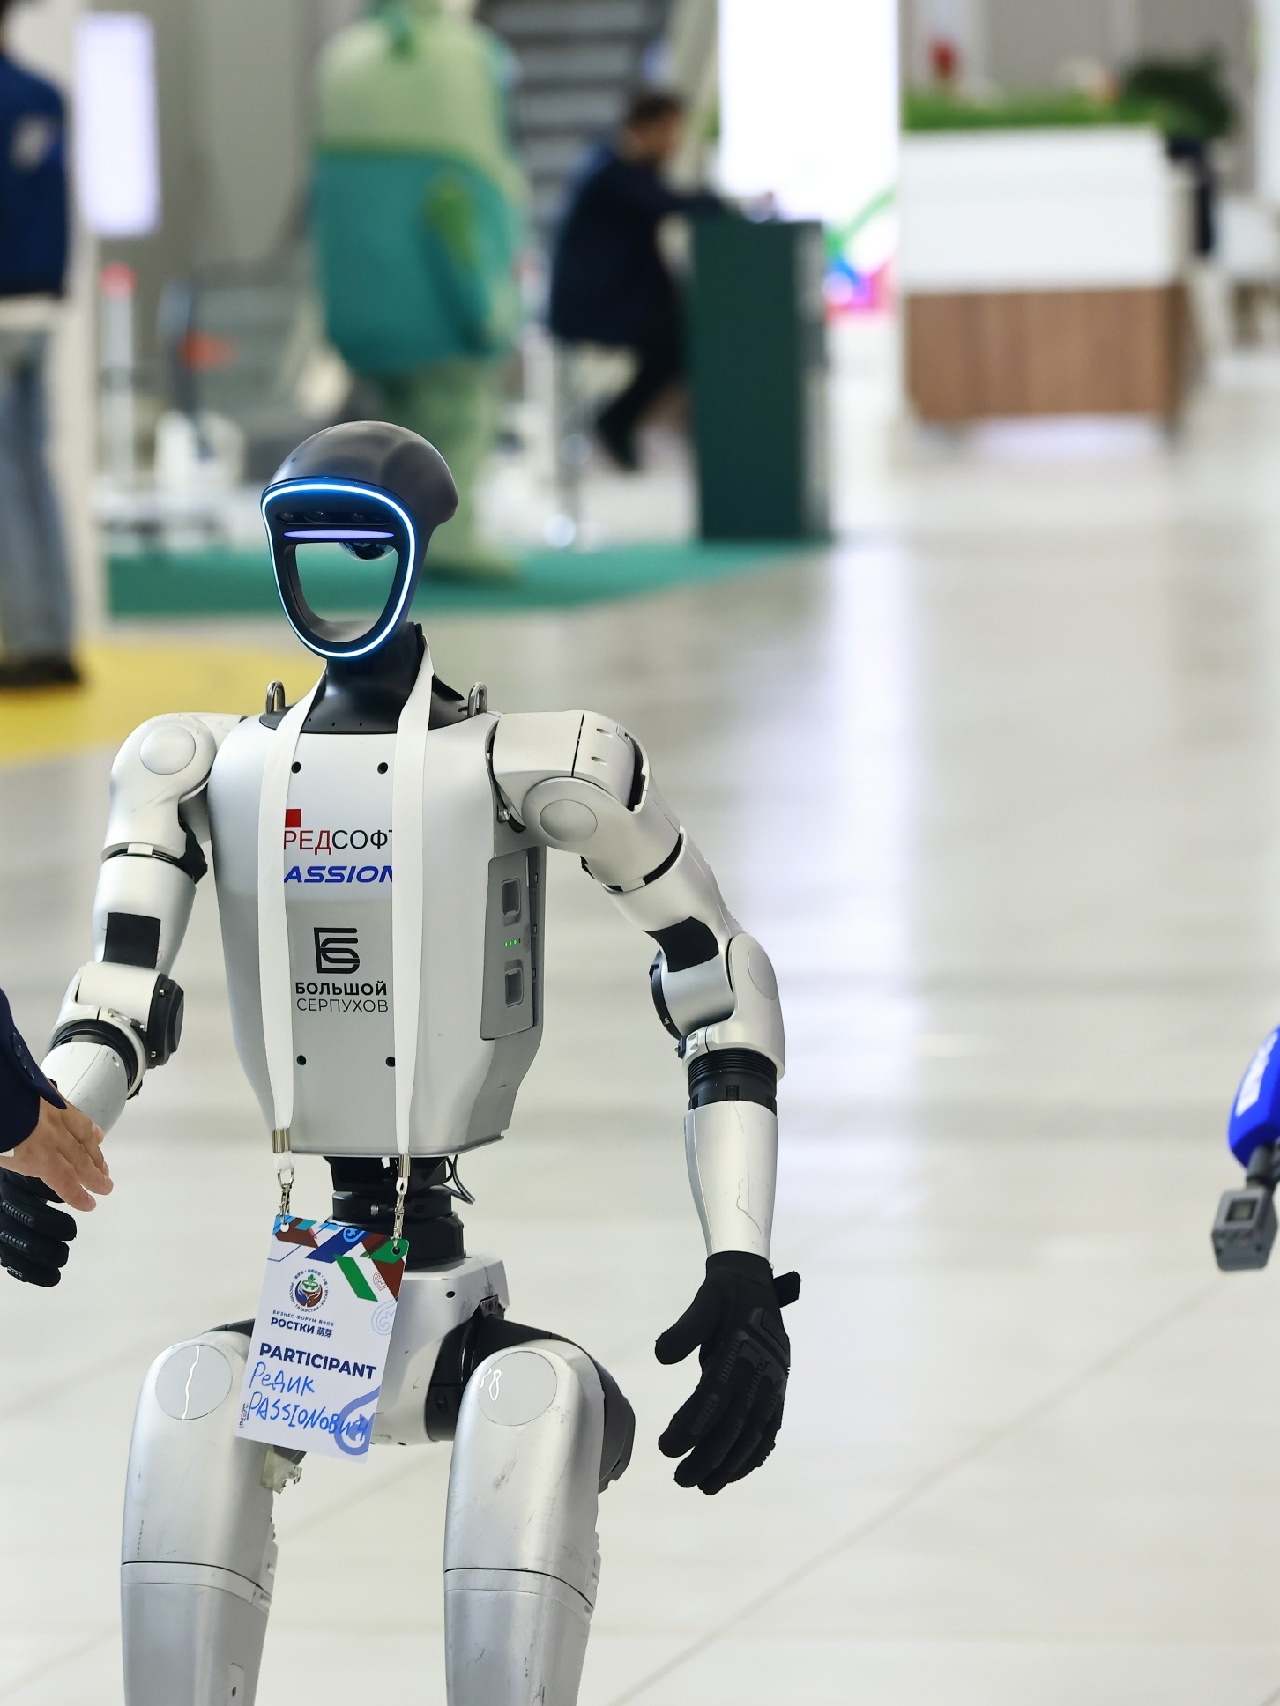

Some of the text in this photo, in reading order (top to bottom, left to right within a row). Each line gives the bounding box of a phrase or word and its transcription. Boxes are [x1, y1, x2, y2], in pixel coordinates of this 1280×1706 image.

[295, 981, 387, 996] БОЛЬШОЙ
[296, 998, 389, 1013] СЕРПУХОВ
[271, 1316, 315, 1335] РОСТКИ
[259, 1342, 377, 1380] PARTICIPANT
